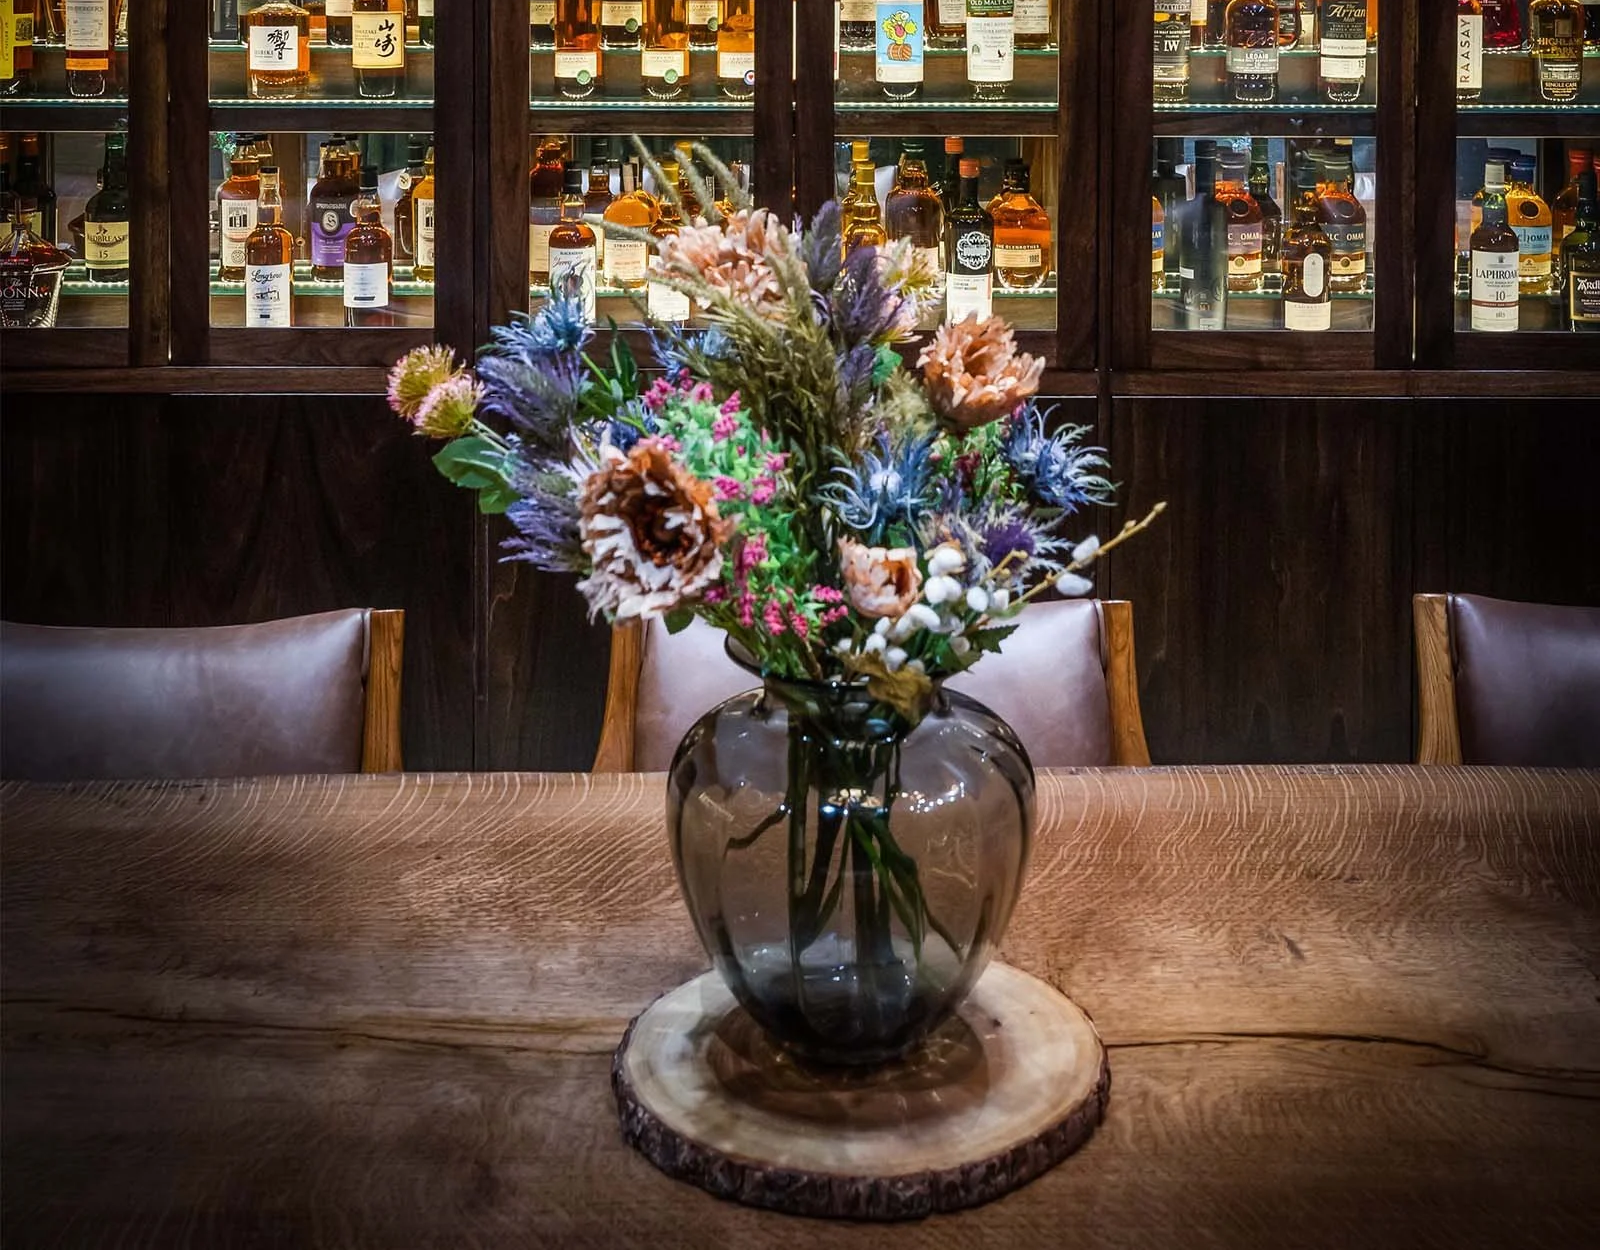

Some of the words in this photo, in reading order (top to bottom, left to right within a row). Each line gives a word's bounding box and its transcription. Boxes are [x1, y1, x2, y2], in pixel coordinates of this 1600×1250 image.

[1328, 4, 1366, 18] Arran
[267, 29, 293, 60] 響
[375, 19, 397, 57] 山崎
[1459, 19, 1471, 83] RAASAY
[1550, 46, 1574, 55] PARK
[98, 250, 109, 259] 15
[251, 269, 282, 284] Longrow
[1495, 291, 1506, 301] 10
